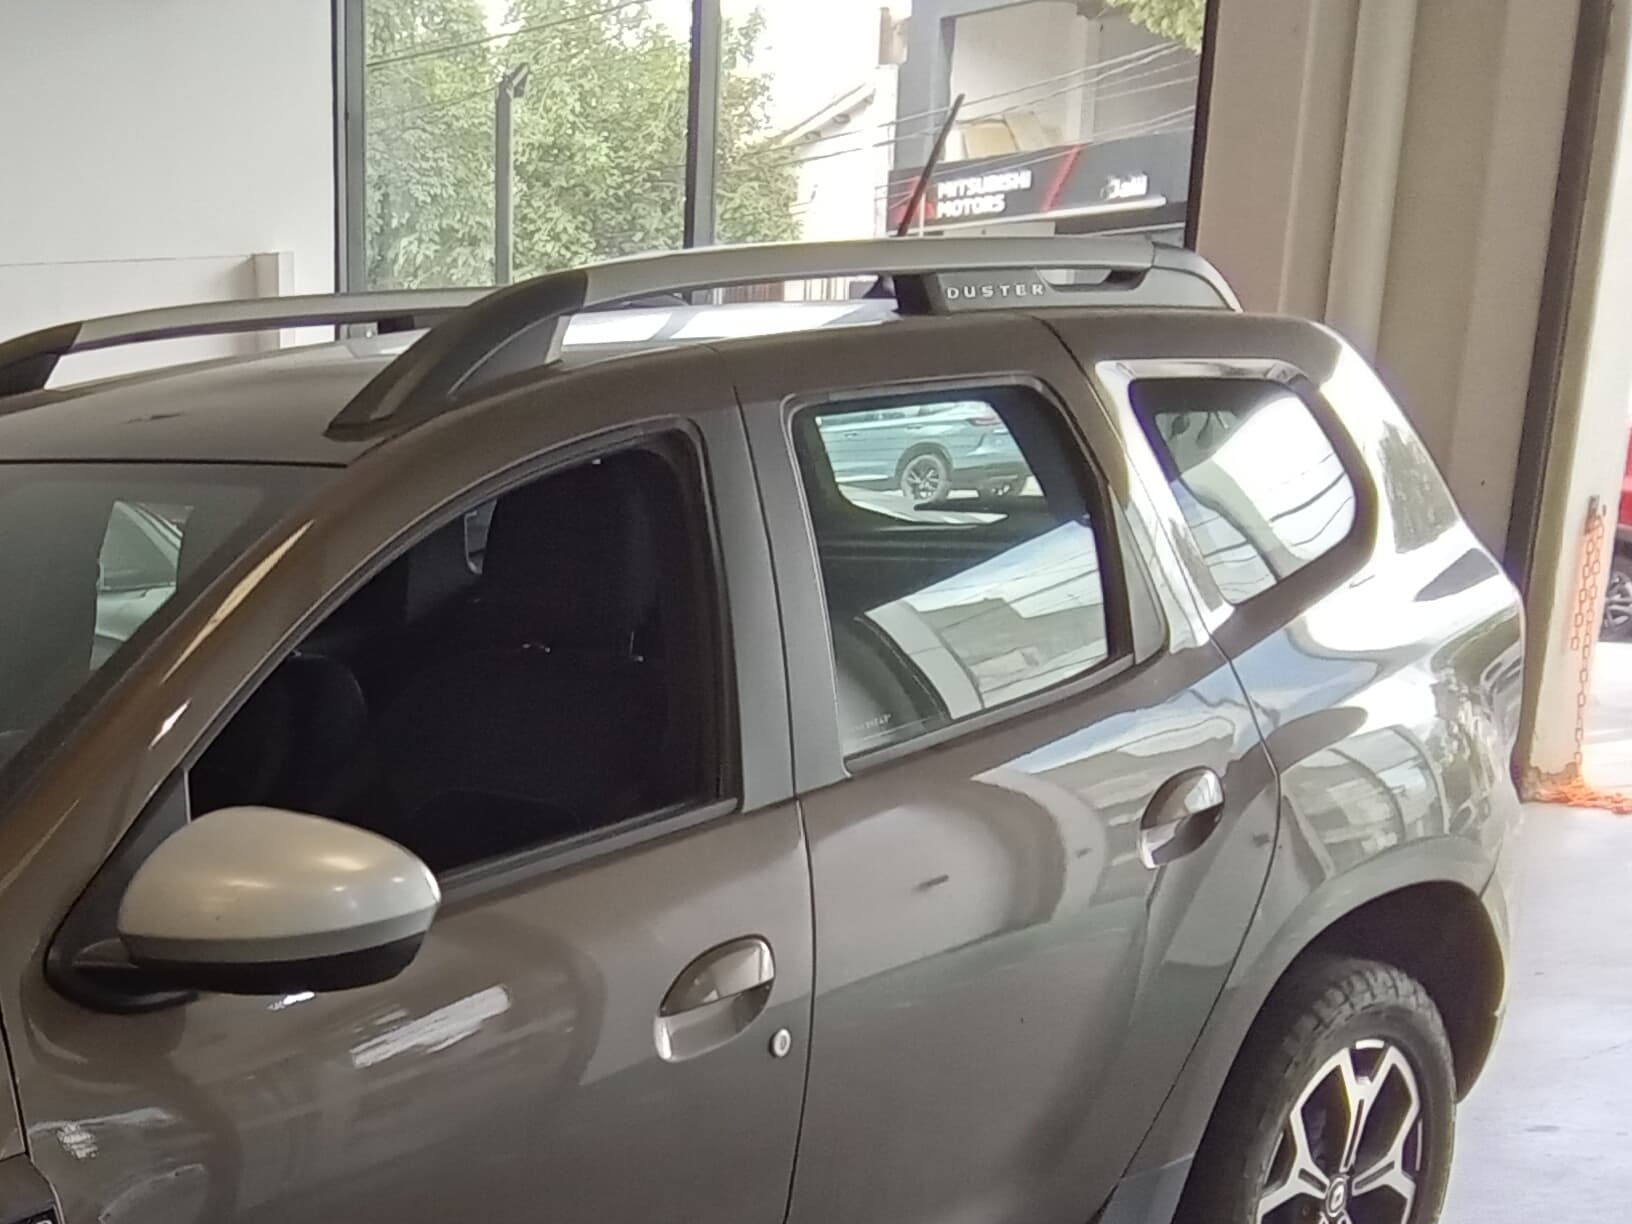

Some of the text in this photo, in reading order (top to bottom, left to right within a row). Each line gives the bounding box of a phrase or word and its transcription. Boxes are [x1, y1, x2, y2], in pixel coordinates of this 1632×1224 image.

[937, 170, 1032, 200] MITSUBISHI
[937, 193, 1006, 219] MOTORS
[947, 284, 1043, 299] DUSTER
